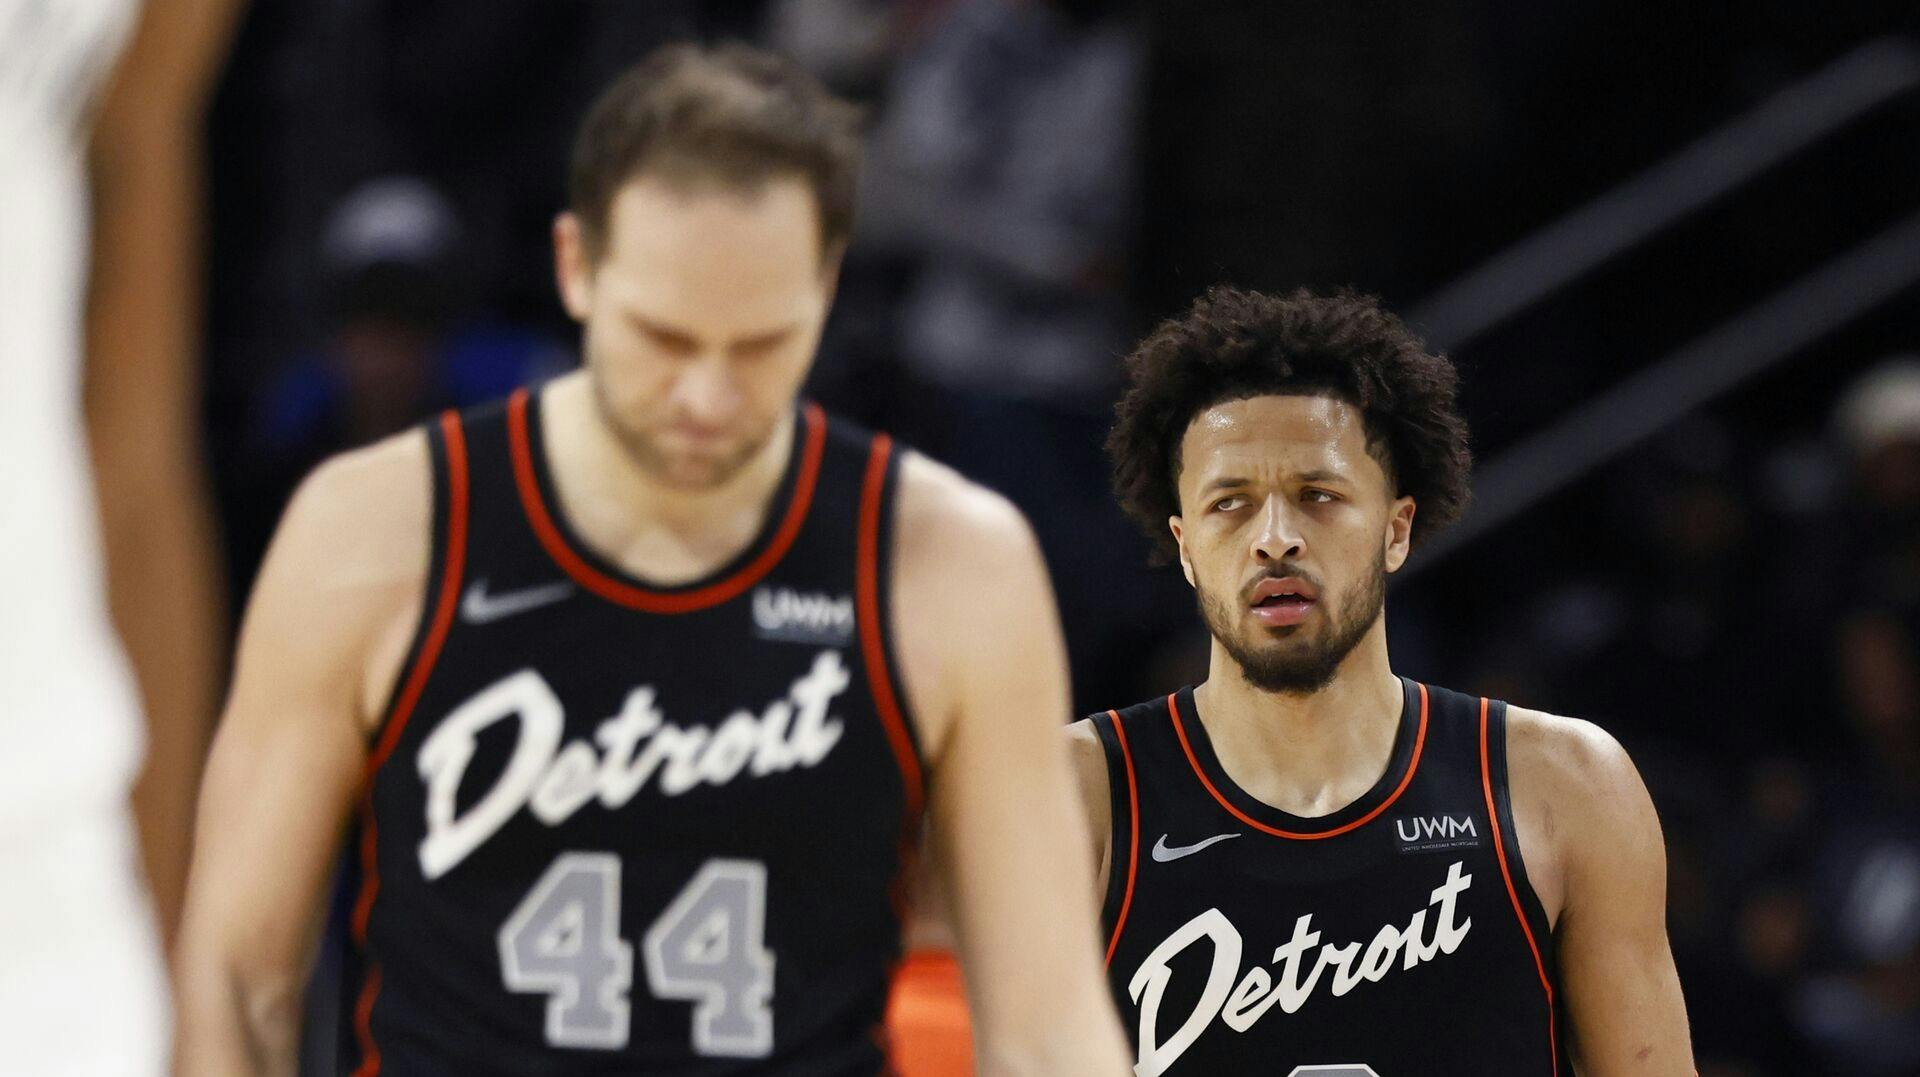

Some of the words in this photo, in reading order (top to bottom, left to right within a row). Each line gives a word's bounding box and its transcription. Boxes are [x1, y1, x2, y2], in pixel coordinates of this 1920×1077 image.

[417, 651, 850, 880] Detroit
[1396, 816, 1477, 841] UWM
[498, 852, 776, 1057] 44
[1128, 861, 1473, 1077] Detroit
